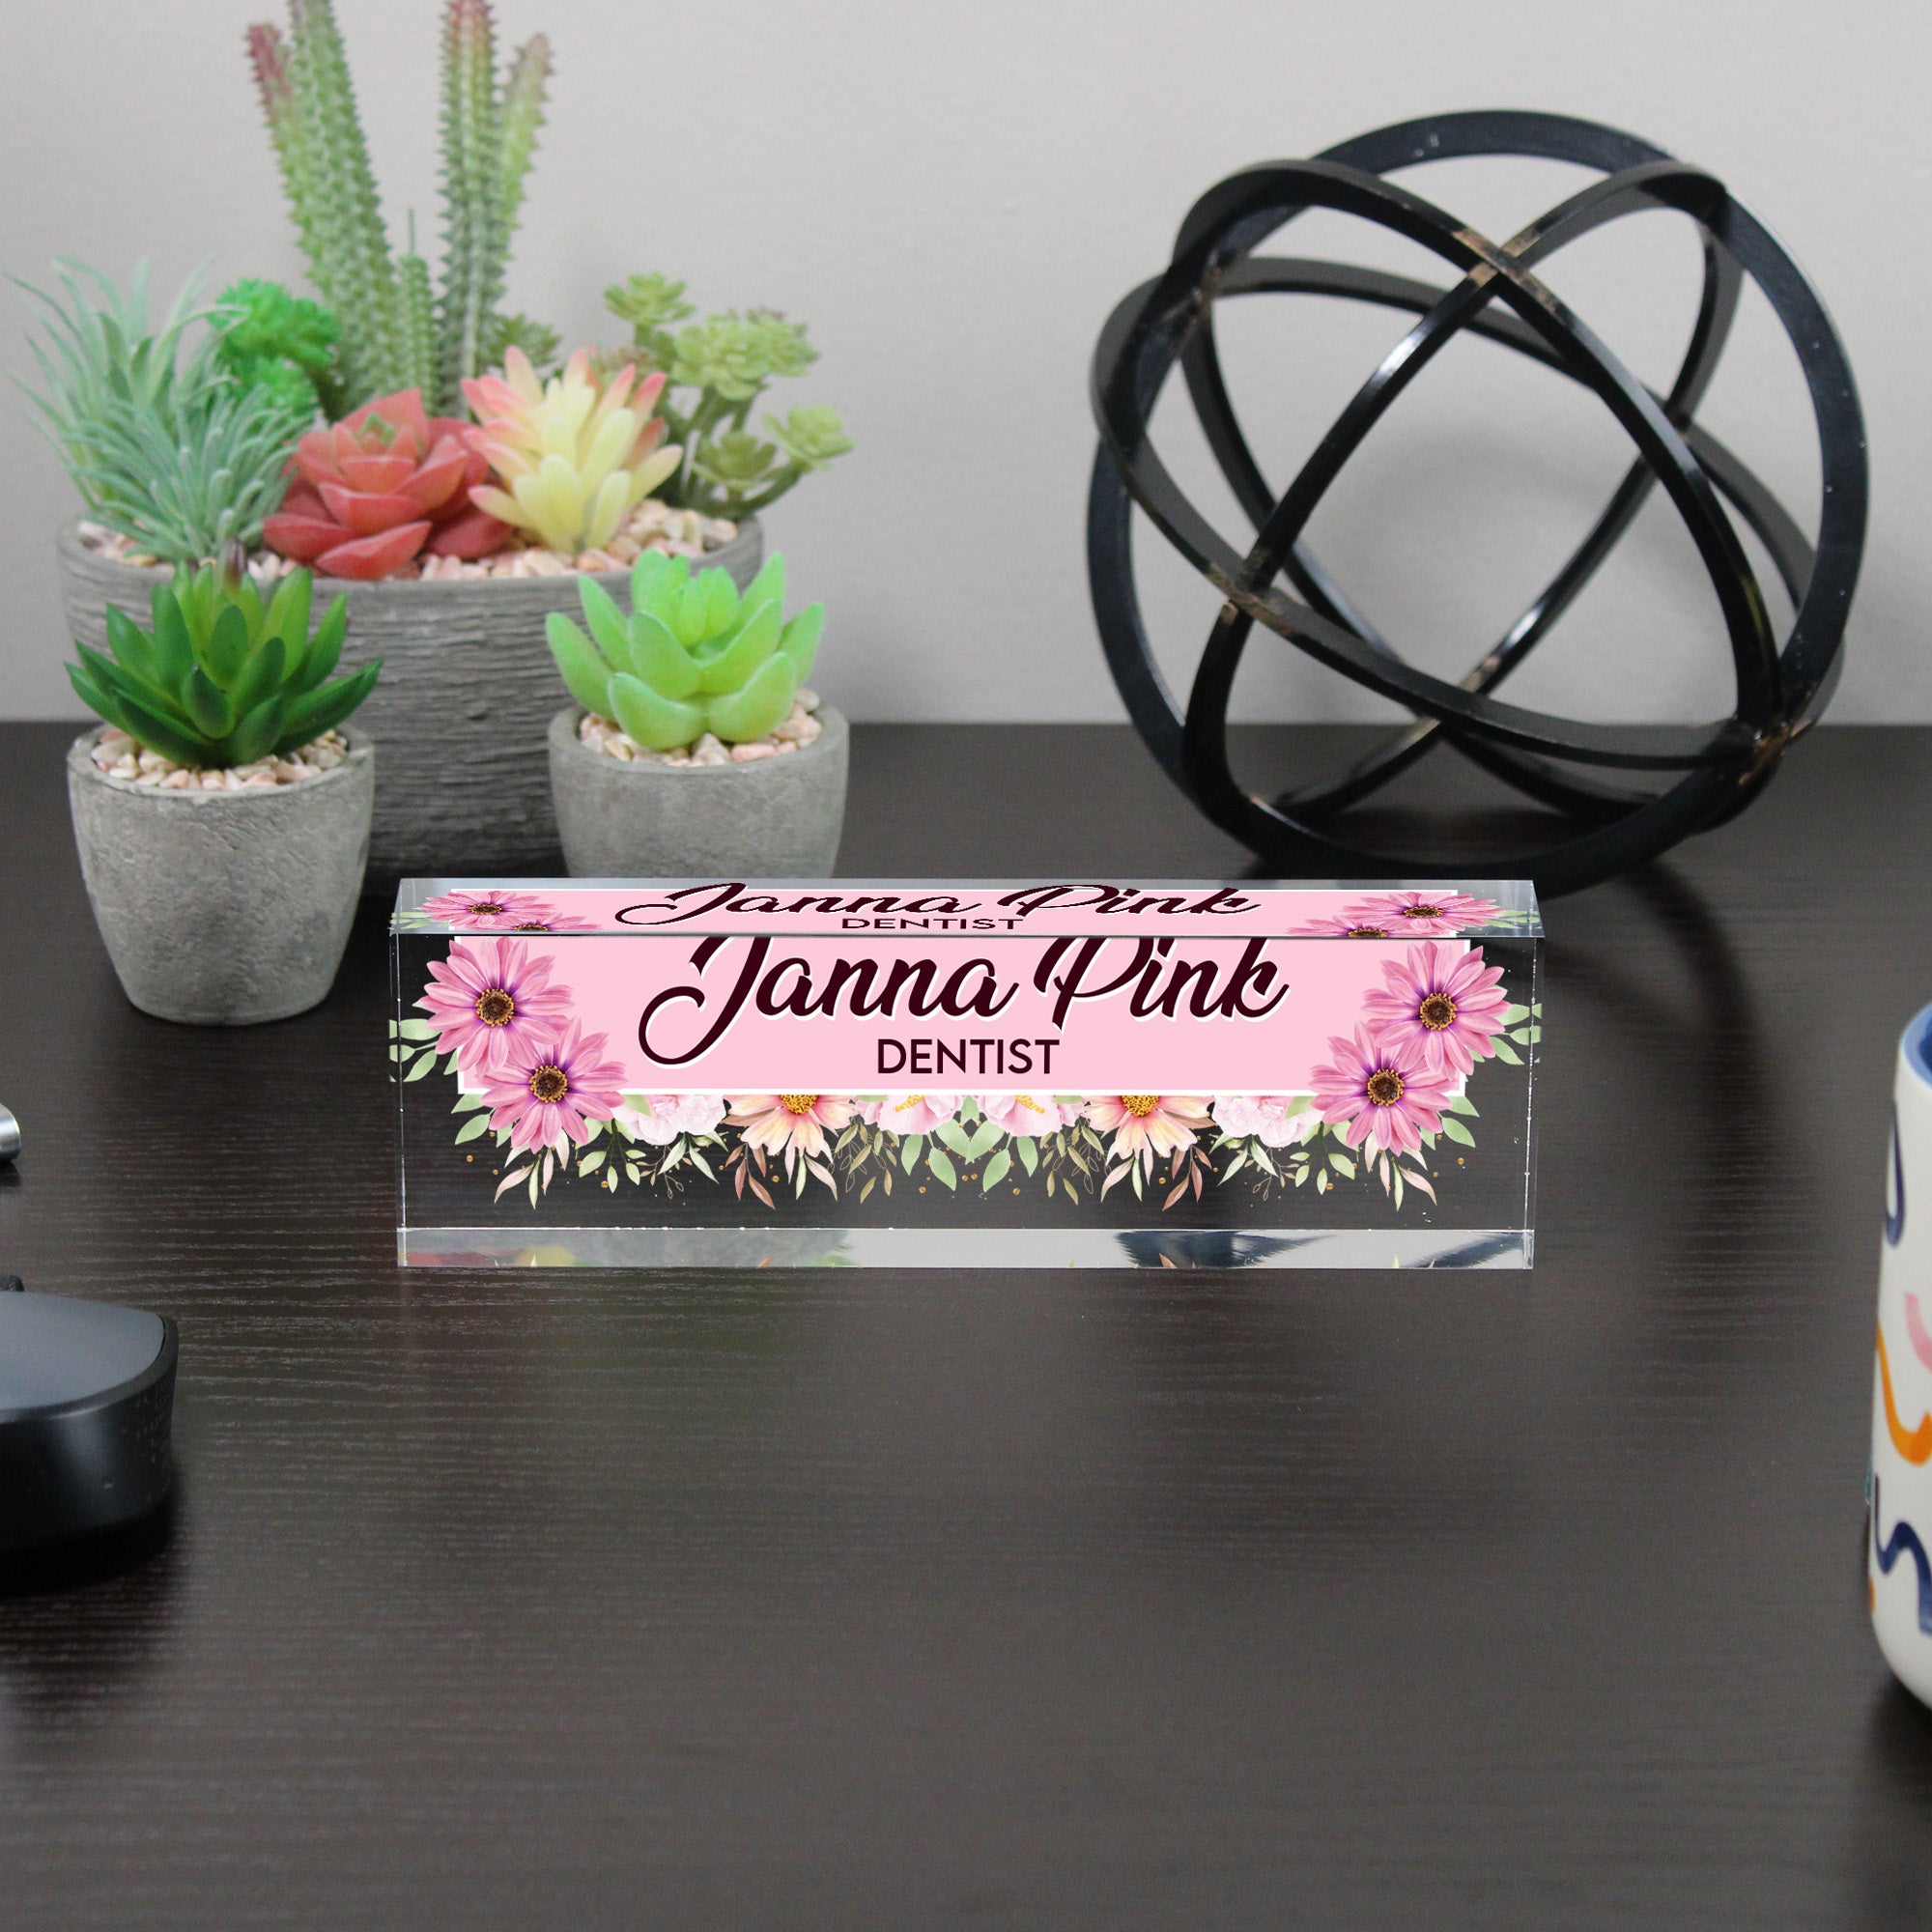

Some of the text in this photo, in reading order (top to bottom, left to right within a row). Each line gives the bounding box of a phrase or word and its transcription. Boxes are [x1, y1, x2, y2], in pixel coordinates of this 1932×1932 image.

[614, 882, 1262, 925] Janna Pink
[841, 918, 1024, 930] DENTIST
[638, 937, 1290, 1066] Janna Pink
[877, 1037, 1061, 1075] DENTIST
